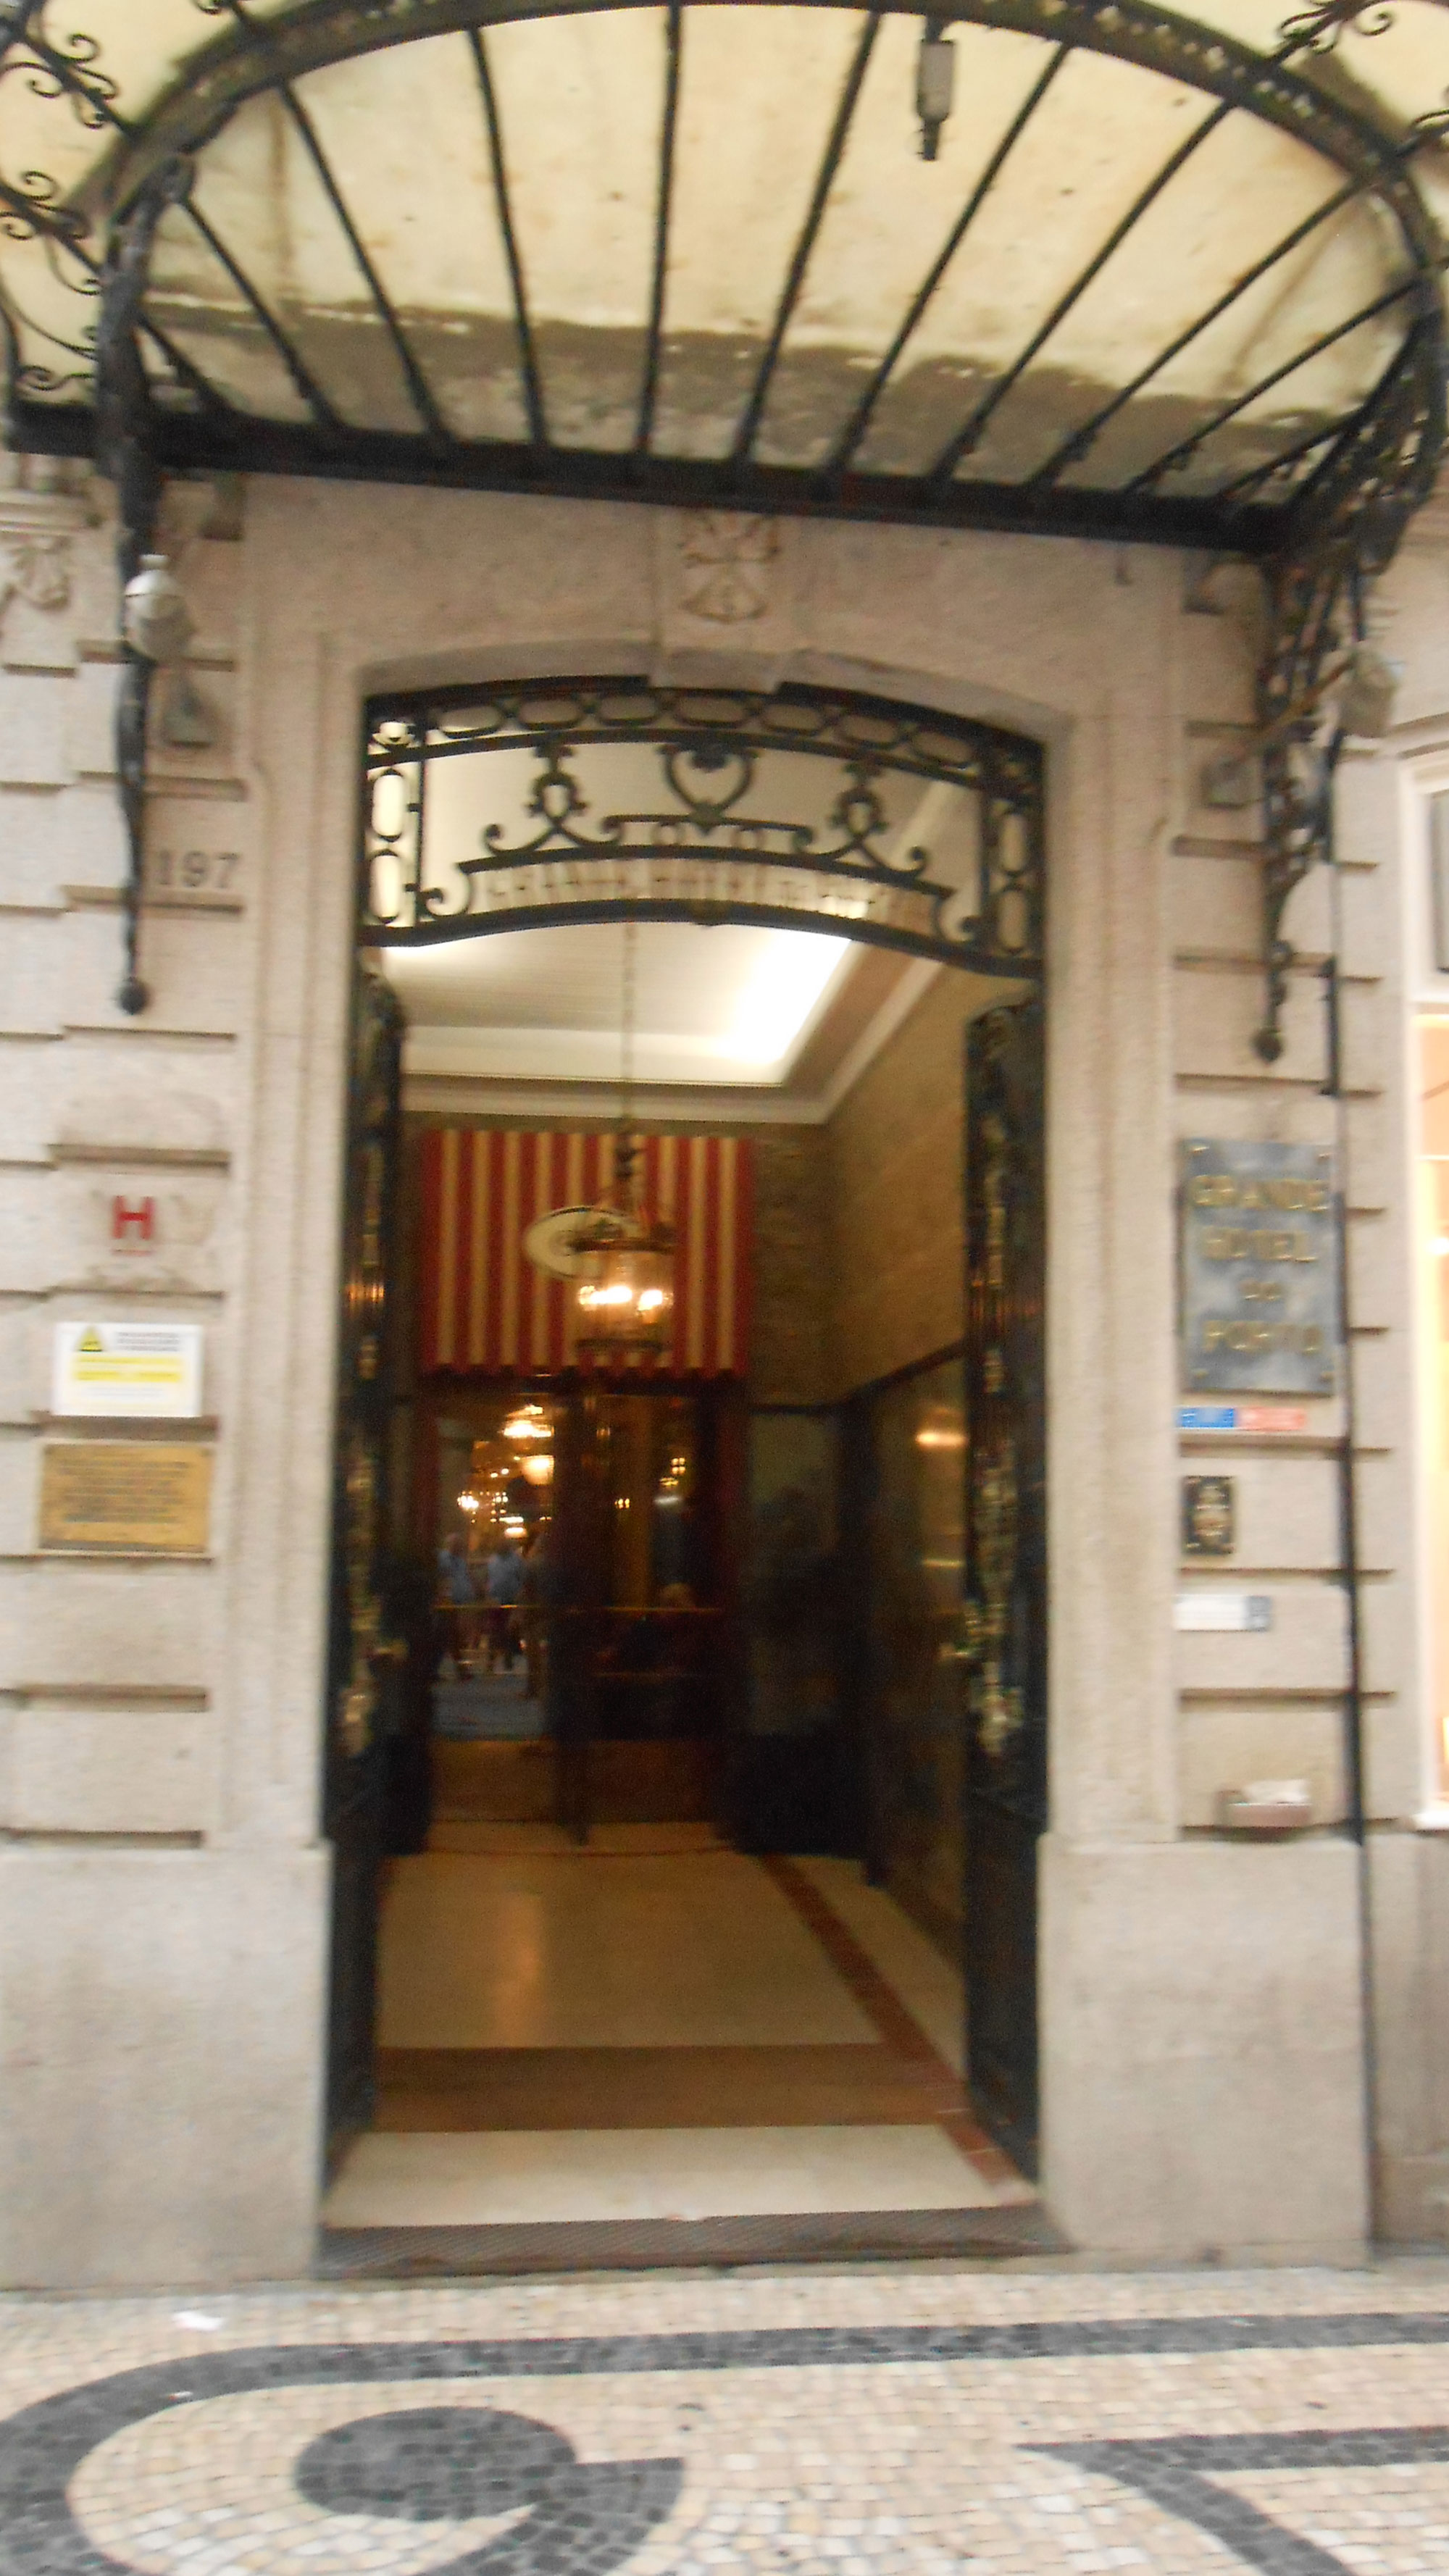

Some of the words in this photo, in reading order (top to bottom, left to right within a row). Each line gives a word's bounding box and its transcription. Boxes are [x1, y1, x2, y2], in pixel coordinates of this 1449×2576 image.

[154, 849, 243, 888] 197
[1190, 1174, 1328, 1212] GRANDE
[112, 1195, 154, 1240] H
[1201, 1226, 1319, 1263] HOTEL
[1202, 1320, 1324, 1353] PORTO
